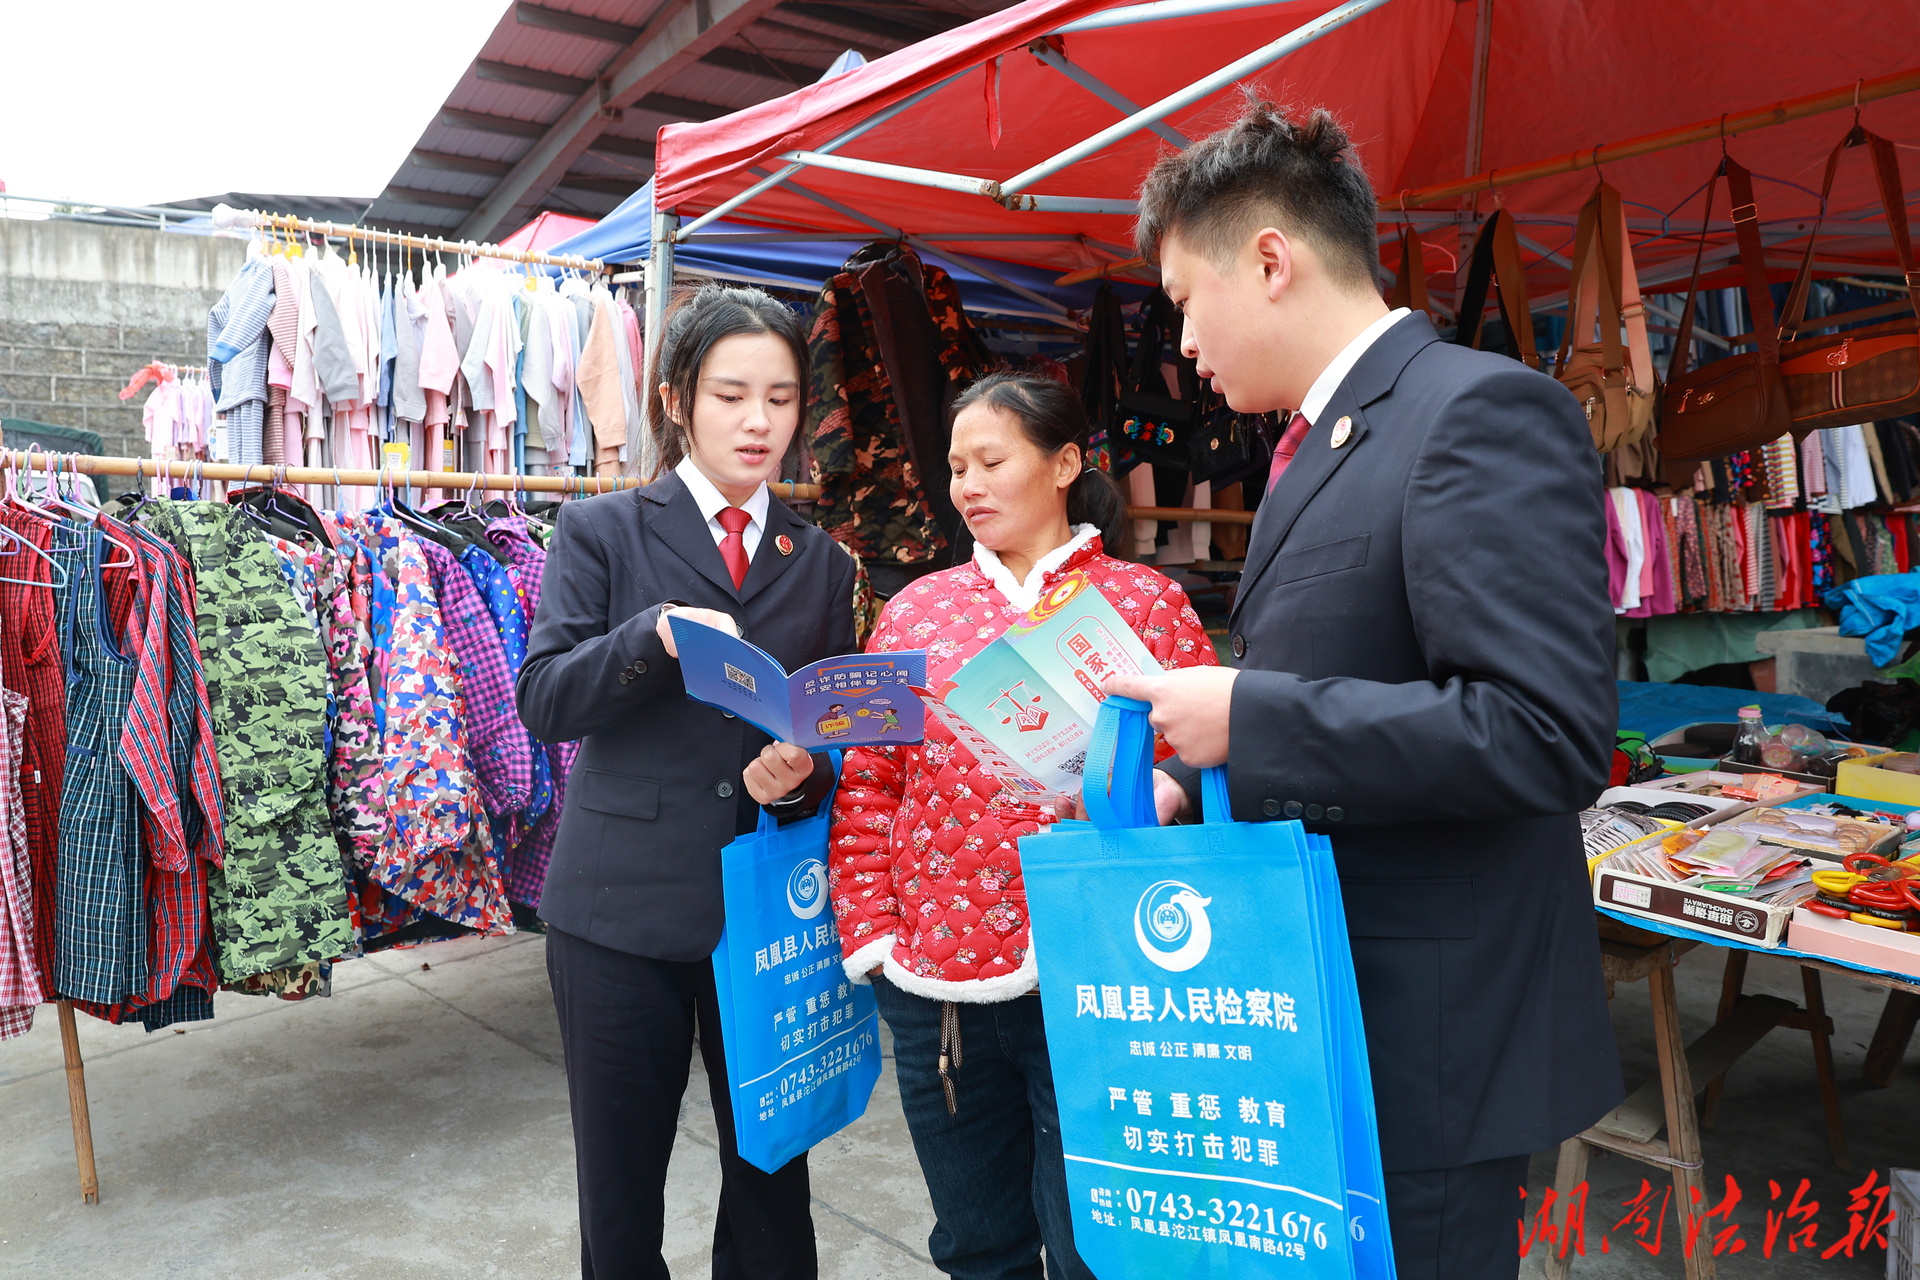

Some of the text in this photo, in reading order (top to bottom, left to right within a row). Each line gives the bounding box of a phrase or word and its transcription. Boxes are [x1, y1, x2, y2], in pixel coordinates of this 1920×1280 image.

[1066, 632, 1116, 682] 国家
[804, 670, 909, 689] 反诈防骗记心间
[805, 678, 909, 696] 平安相伴每一天
[1683, 897, 1734, 915] CHAOHUAWAYE
[784, 970, 799, 985] 忠诚
[801, 963, 815, 979] 公正
[773, 1005, 797, 1032] 严管
[805, 990, 830, 1016] 重惩
[780, 1001, 854, 1052] 切实打击犯罪
[1075, 984, 1298, 1033] 凤凰县人民检察院
[1129, 1041, 1253, 1062] 忠诚 公正 清廉 文明
[1108, 1086, 1286, 1129] 严管 重惩 教育
[1122, 1126, 1280, 1167] 切实打击犯罪
